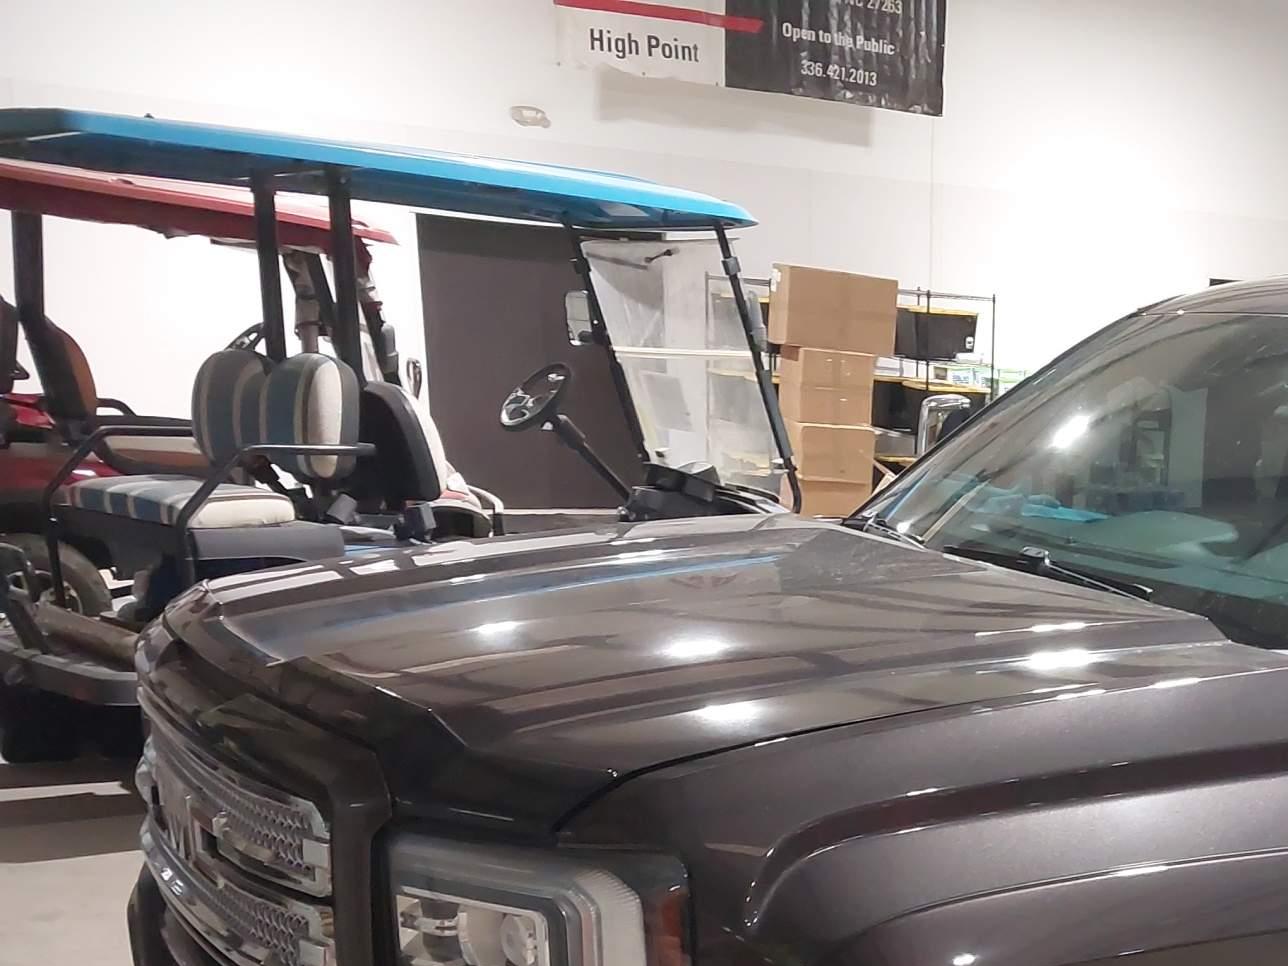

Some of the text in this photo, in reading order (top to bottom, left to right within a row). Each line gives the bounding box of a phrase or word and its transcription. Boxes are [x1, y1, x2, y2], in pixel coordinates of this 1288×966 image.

[589, 28, 699, 62] High Point
[782, 22, 896, 55] Open to the Public
[801, 61, 877, 86] 336.421.2013
